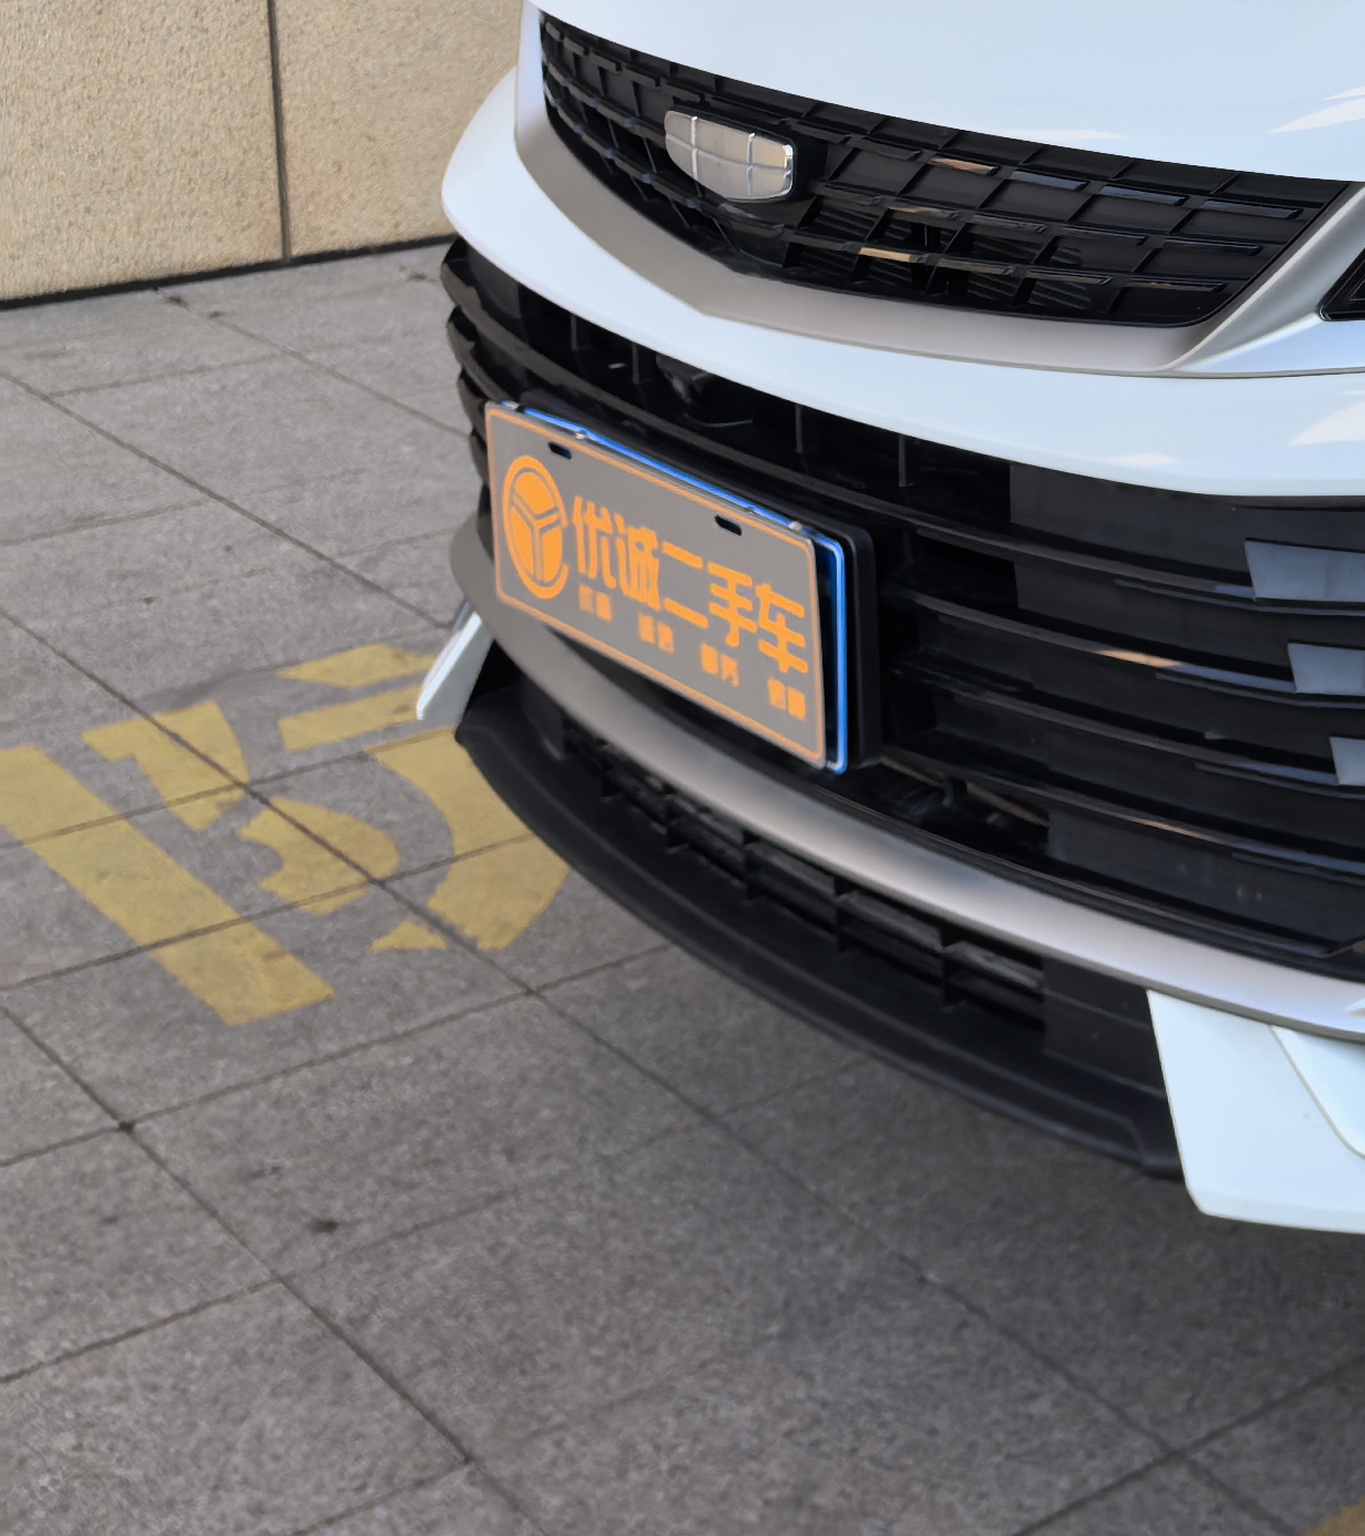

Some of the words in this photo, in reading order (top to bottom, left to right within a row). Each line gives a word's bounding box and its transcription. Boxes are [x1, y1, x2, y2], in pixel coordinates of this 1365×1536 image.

[572, 496, 809, 674] 优诚二手车
